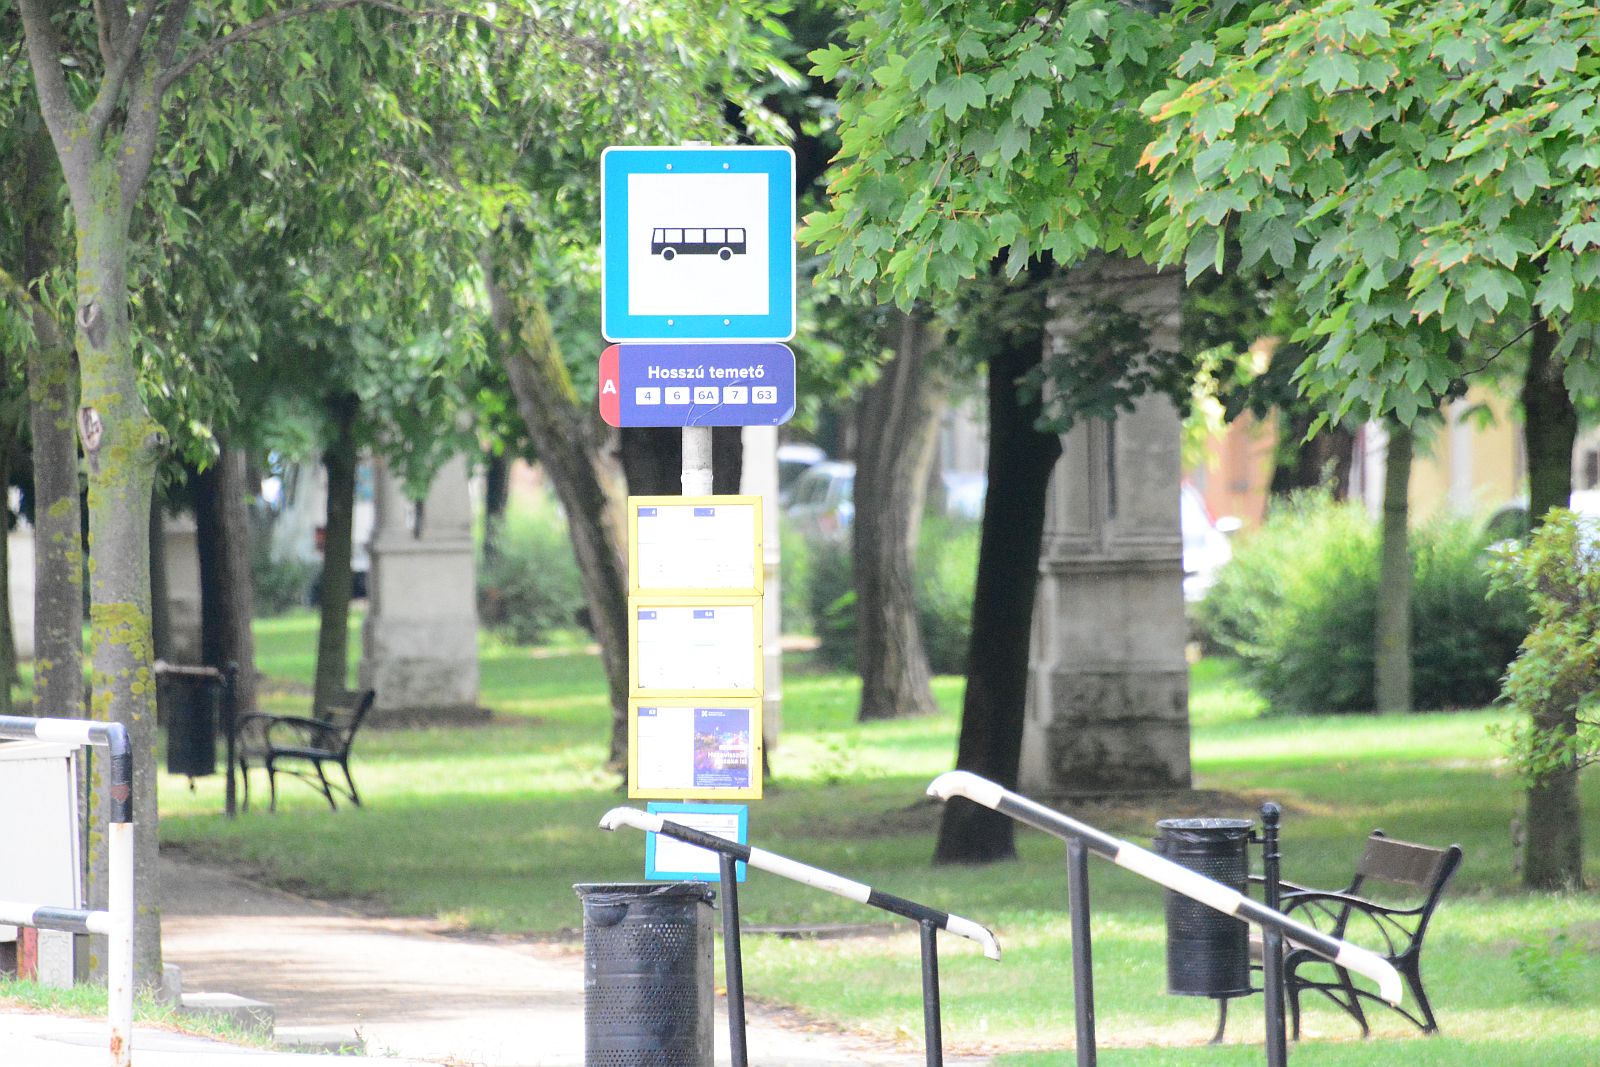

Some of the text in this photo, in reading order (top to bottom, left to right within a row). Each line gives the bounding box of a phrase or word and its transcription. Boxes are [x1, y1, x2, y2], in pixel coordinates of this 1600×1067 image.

[648, 364, 765, 379] Hosszú temető
[602, 379, 617, 395] A
[644, 390, 772, 400] 4 6 6A 7 63
